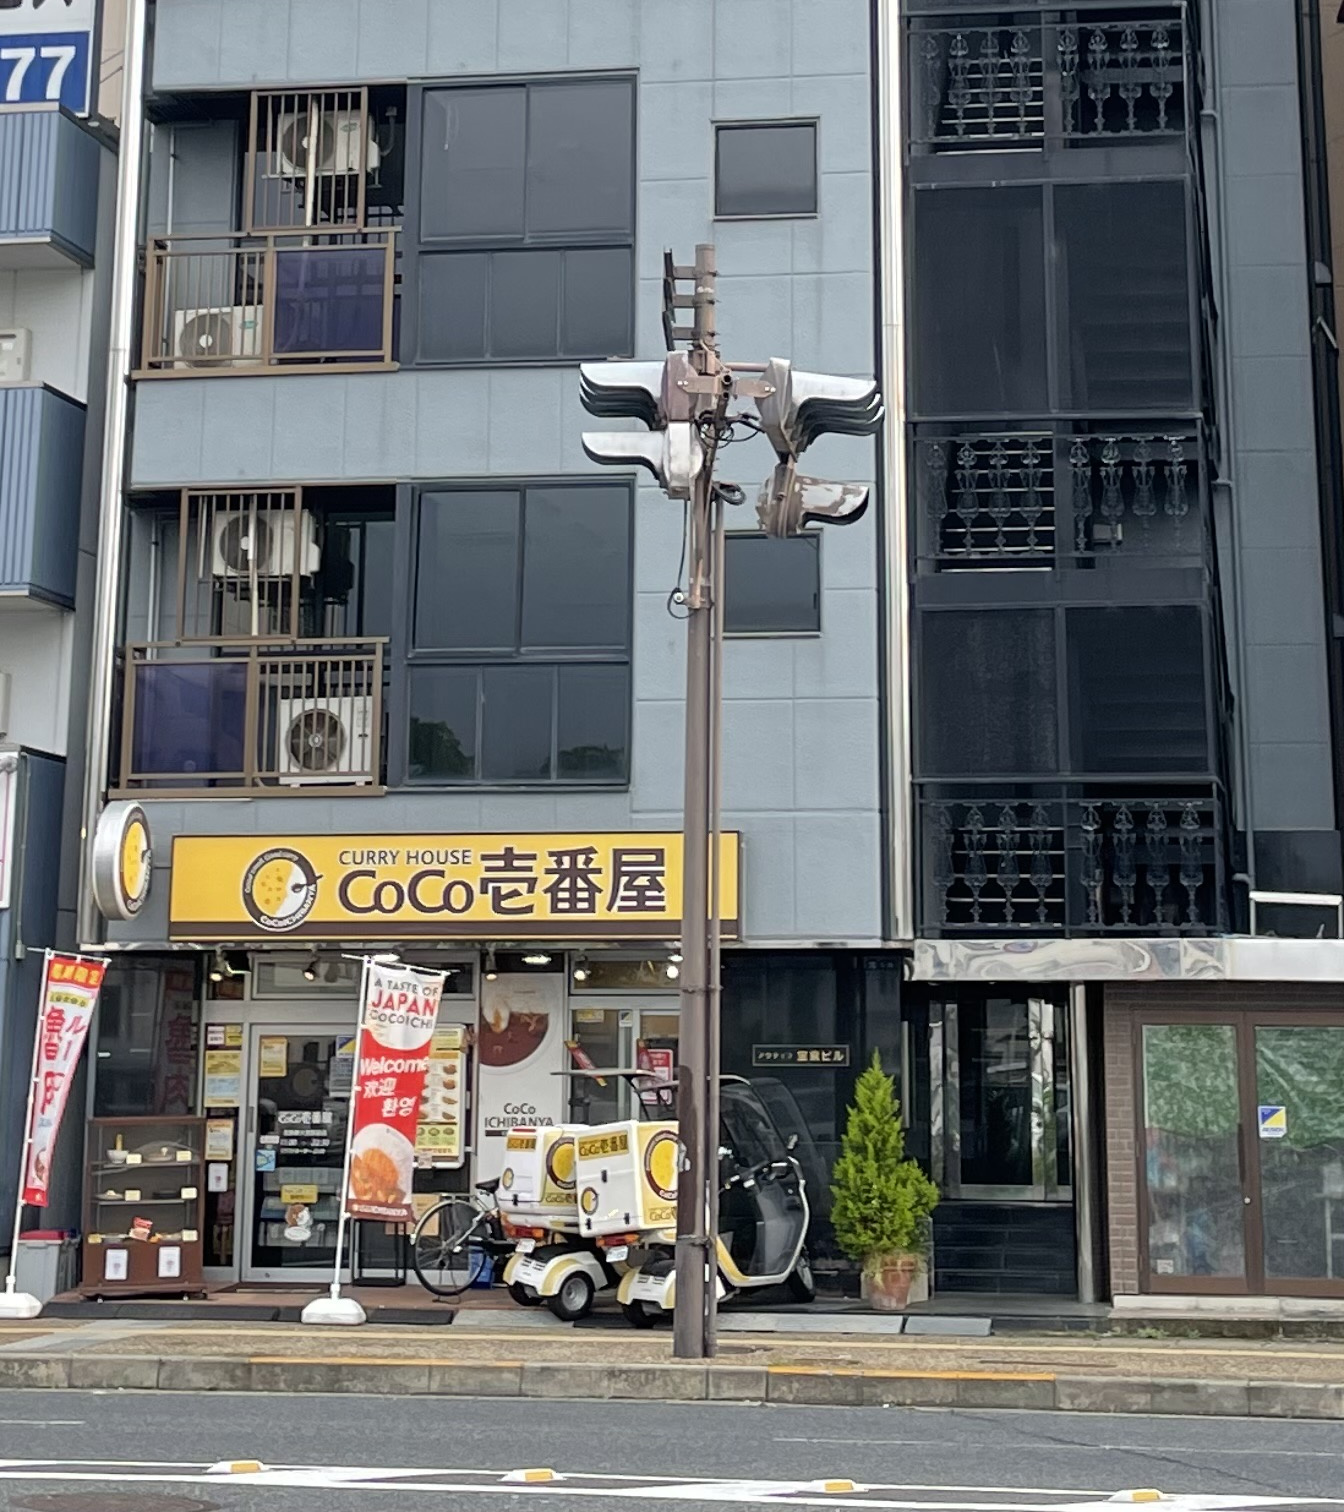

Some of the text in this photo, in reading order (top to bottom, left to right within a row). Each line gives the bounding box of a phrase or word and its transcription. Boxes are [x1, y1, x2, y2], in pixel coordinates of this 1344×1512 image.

[338, 848, 472, 866] CURRY HOUSE
[374, 978, 439, 997] A TASTE OF
[371, 989, 439, 1017] JAPAN
[503, 1102, 536, 1115] CoCo
